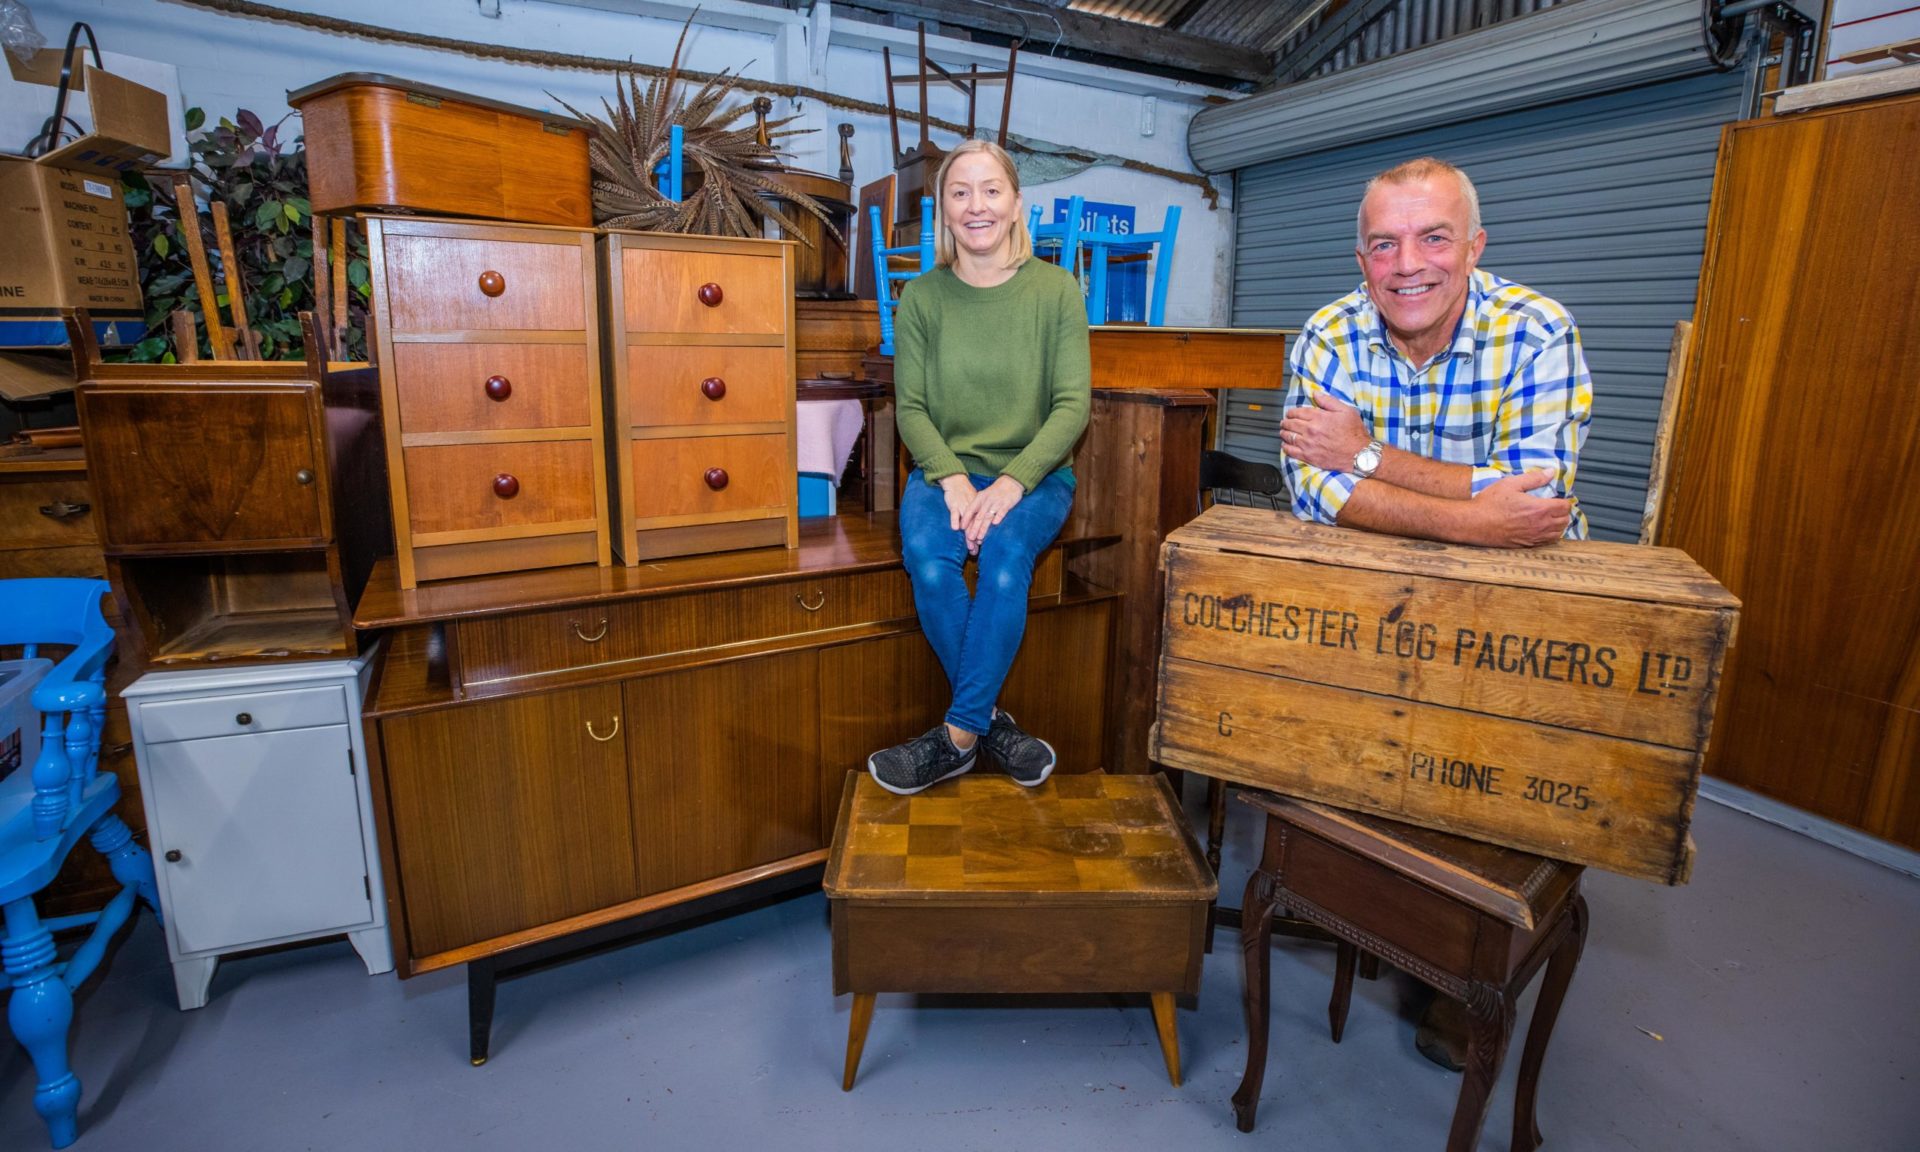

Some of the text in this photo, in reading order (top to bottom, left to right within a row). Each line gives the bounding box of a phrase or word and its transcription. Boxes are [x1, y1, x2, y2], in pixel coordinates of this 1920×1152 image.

[1060, 208, 1130, 235] ilts
[1183, 591, 1359, 651] COLCHESTER
[1376, 617, 1438, 661] EGG
[1453, 628, 1617, 689] PACKERS
[1410, 752, 1590, 812] PHONE 3025
